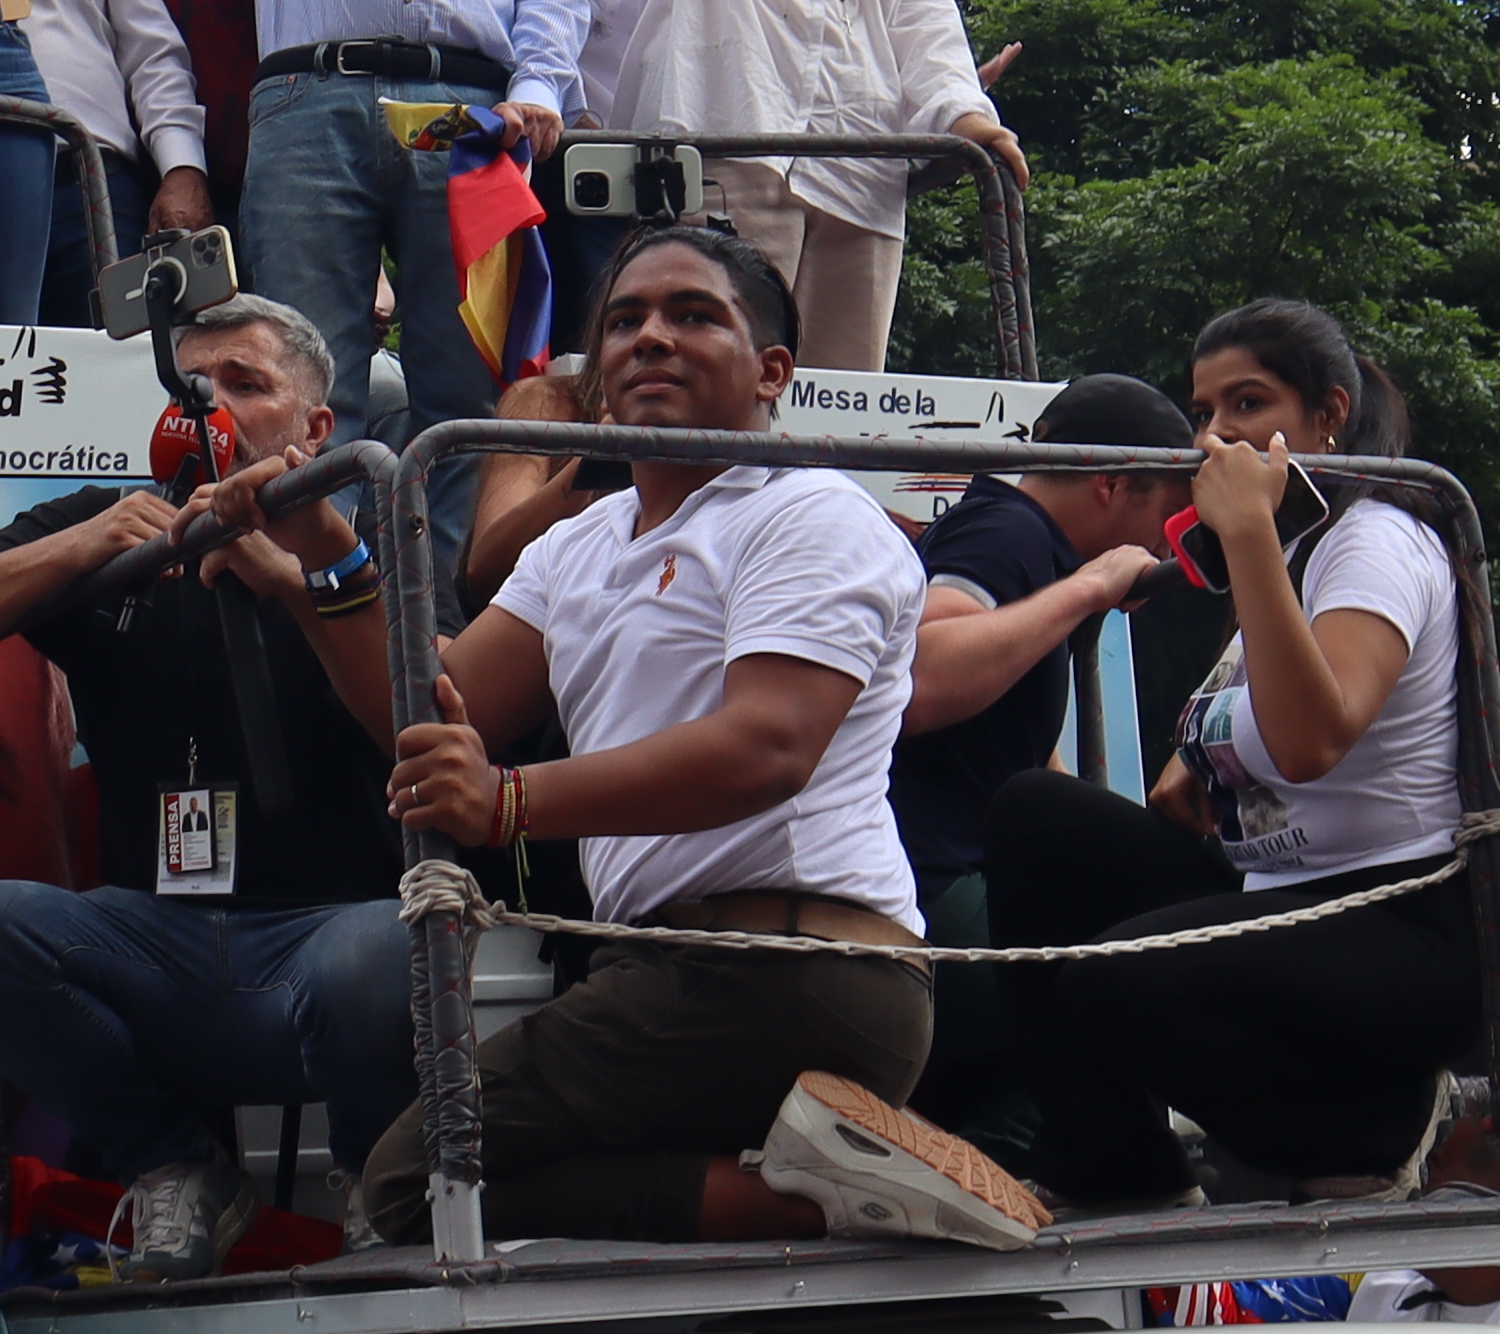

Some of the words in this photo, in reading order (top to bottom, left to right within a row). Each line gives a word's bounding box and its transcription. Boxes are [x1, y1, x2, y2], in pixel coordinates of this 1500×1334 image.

[790, 380, 868, 412] Mesa
[879, 387, 911, 415] de
[915, 388, 935, 416] la
[167, 800, 181, 865] PRENSA
[1258, 827, 1309, 857] TOUR
